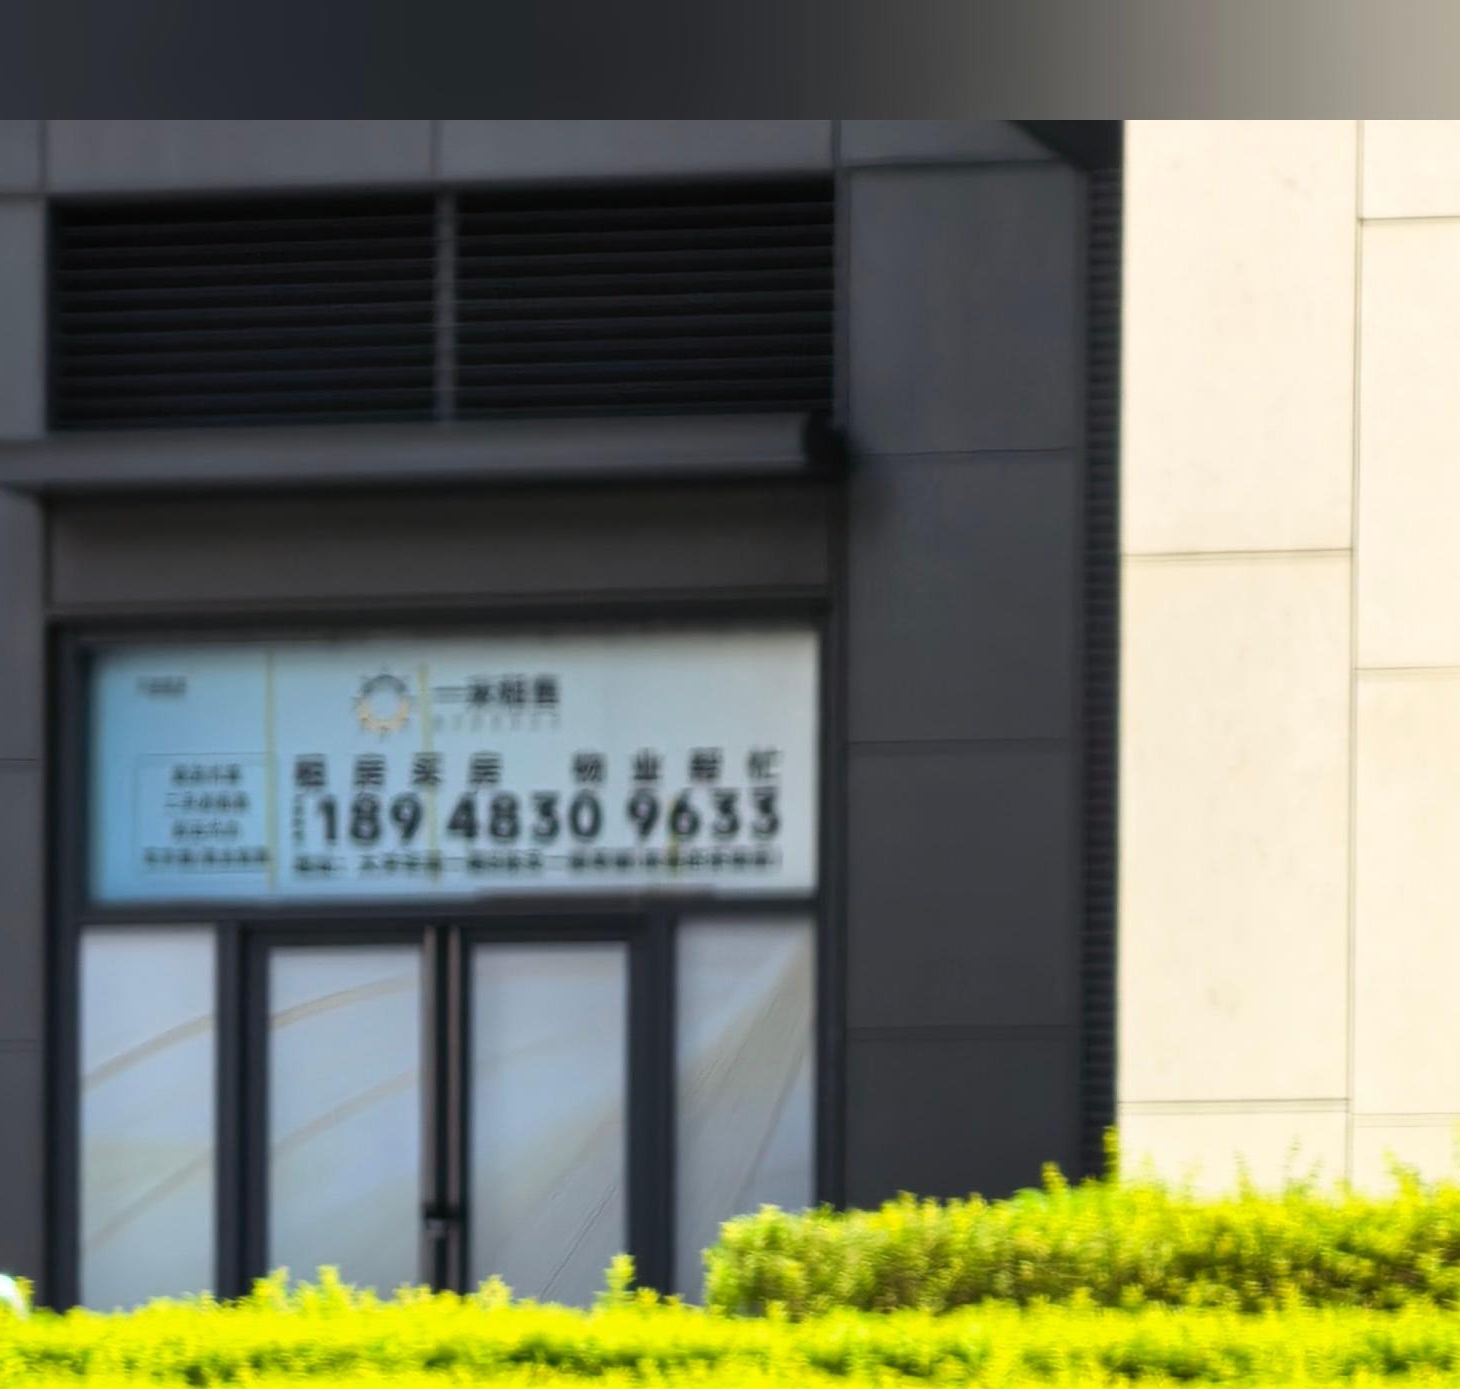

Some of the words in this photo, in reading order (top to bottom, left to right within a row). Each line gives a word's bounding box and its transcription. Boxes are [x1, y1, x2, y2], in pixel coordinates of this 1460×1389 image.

[317, 791, 425, 844] 189
[447, 789, 603, 843] 4830
[628, 786, 782, 842] 9633
